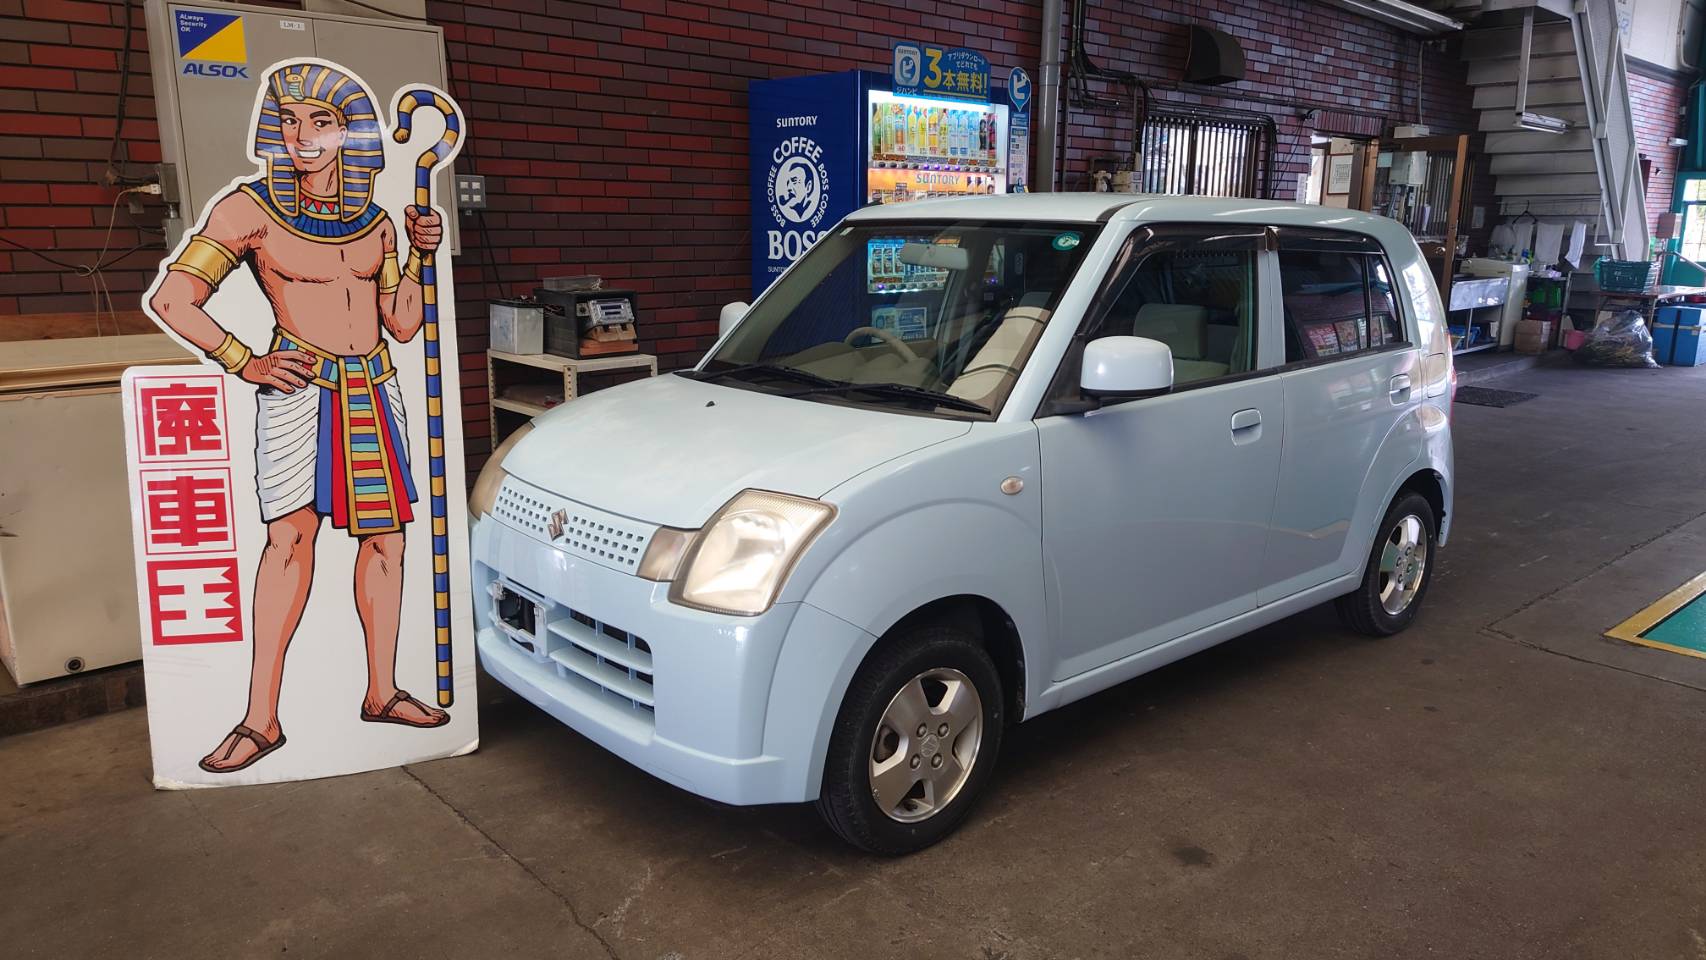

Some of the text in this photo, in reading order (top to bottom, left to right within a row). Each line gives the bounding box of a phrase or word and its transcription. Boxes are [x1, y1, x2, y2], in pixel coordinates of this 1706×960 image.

[180, 20, 208, 29] Security
[183, 63, 248, 78] ALSOK
[776, 116, 818, 128] SUNTORY
[773, 137, 823, 163] COFFEE
[916, 173, 960, 185] SUNTORY
[767, 165, 786, 228] BOSS COFFEE
[811, 163, 829, 228] BOSS COFFEE
[767, 230, 829, 261] BOS
